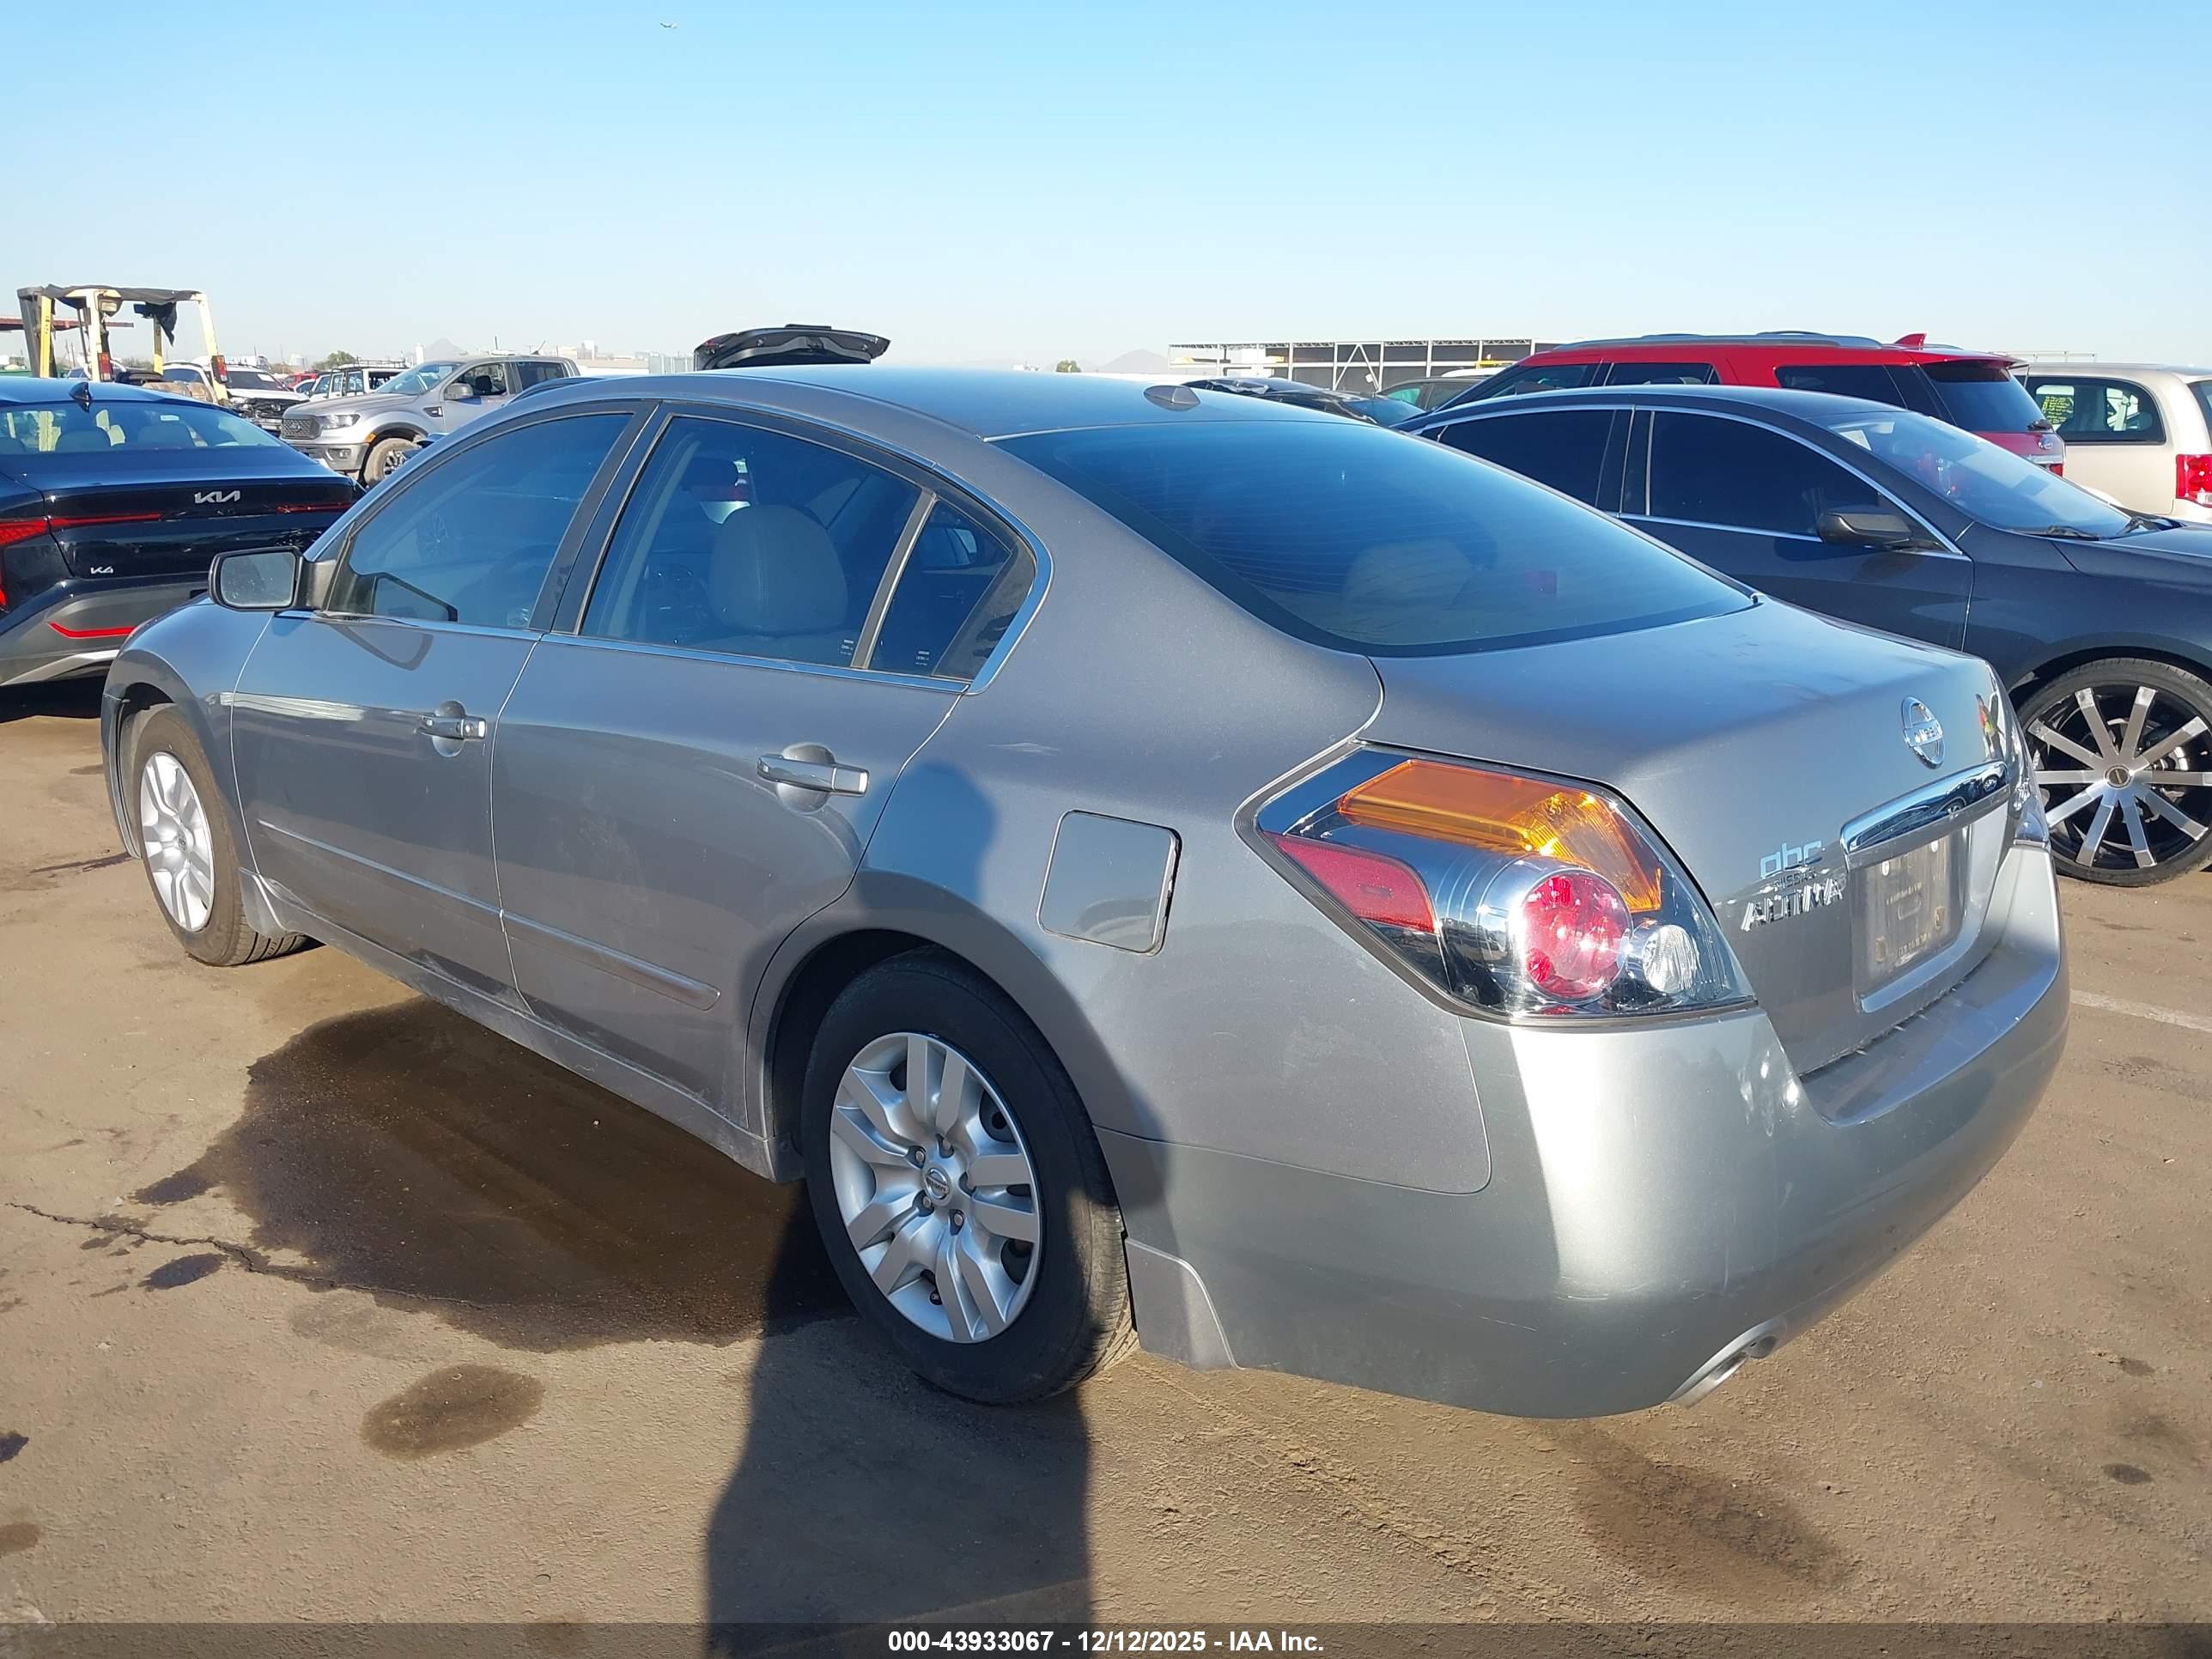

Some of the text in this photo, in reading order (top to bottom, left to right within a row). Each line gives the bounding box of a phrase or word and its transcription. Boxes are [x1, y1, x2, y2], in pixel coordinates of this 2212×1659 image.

[194, 490, 241, 504] KIA
[90, 566, 114, 574] K4
[1741, 878, 1843, 932] ALTIMA
